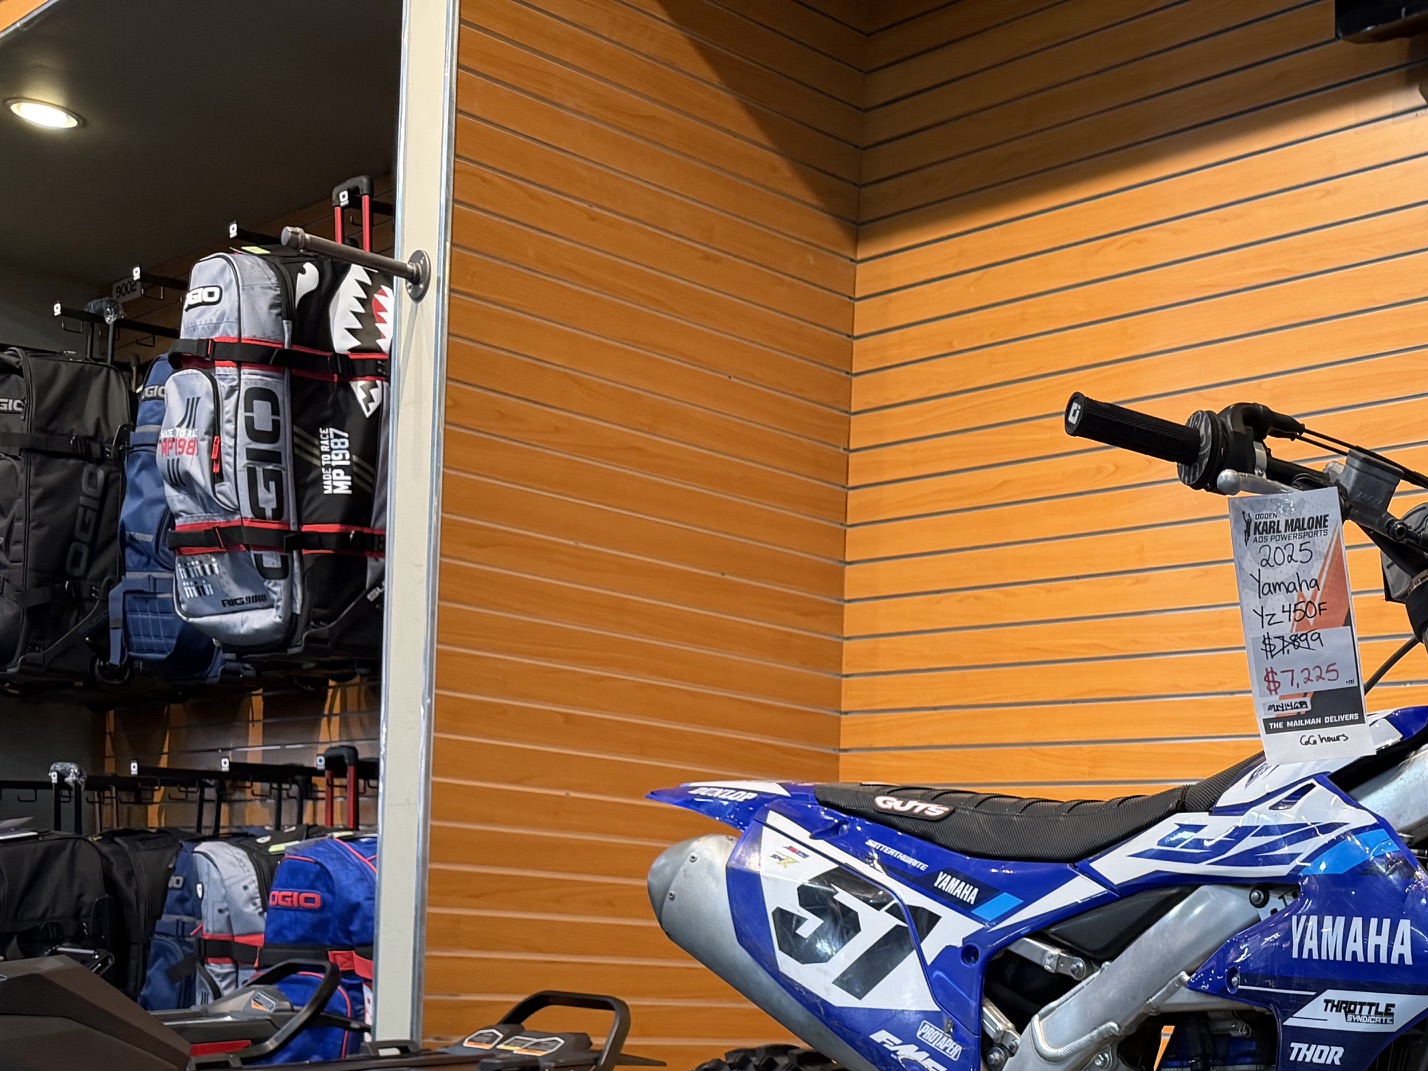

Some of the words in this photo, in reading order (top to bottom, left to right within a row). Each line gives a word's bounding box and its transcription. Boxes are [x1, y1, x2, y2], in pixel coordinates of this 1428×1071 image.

[319, 427, 330, 451] RACE
[329, 427, 351, 466] 1987
[321, 454, 331, 466] TO
[322, 467, 332, 494] MADE
[332, 469, 352, 494] MP
[1253, 520, 1282, 535] KARL
[1284, 514, 1329, 533] MALONE
[1270, 529, 1328, 542] POWERSPORTS
[1259, 541, 1313, 567] 2025
[1250, 569, 1320, 599] Yamaha
[1264, 662, 1339, 695] $7,225
[1287, 717, 1321, 727] MAILMAN
[1325, 713, 1359, 723] DELIVERS
[1318, 734, 1349, 744] hours
[689, 786, 758, 802] DUNLOP
[874, 796, 949, 816] GUTS
[269, 891, 321, 908] OGIO
[933, 871, 979, 905] YAMAHA
[1291, 915, 1413, 965] YAMAHA
[1323, 999, 1396, 1018] THROTTLE
[1346, 1014, 1394, 1024] SYNDICATE
[918, 1022, 962, 1060] PROTAPER
[1289, 1042, 1344, 1065] THOR
